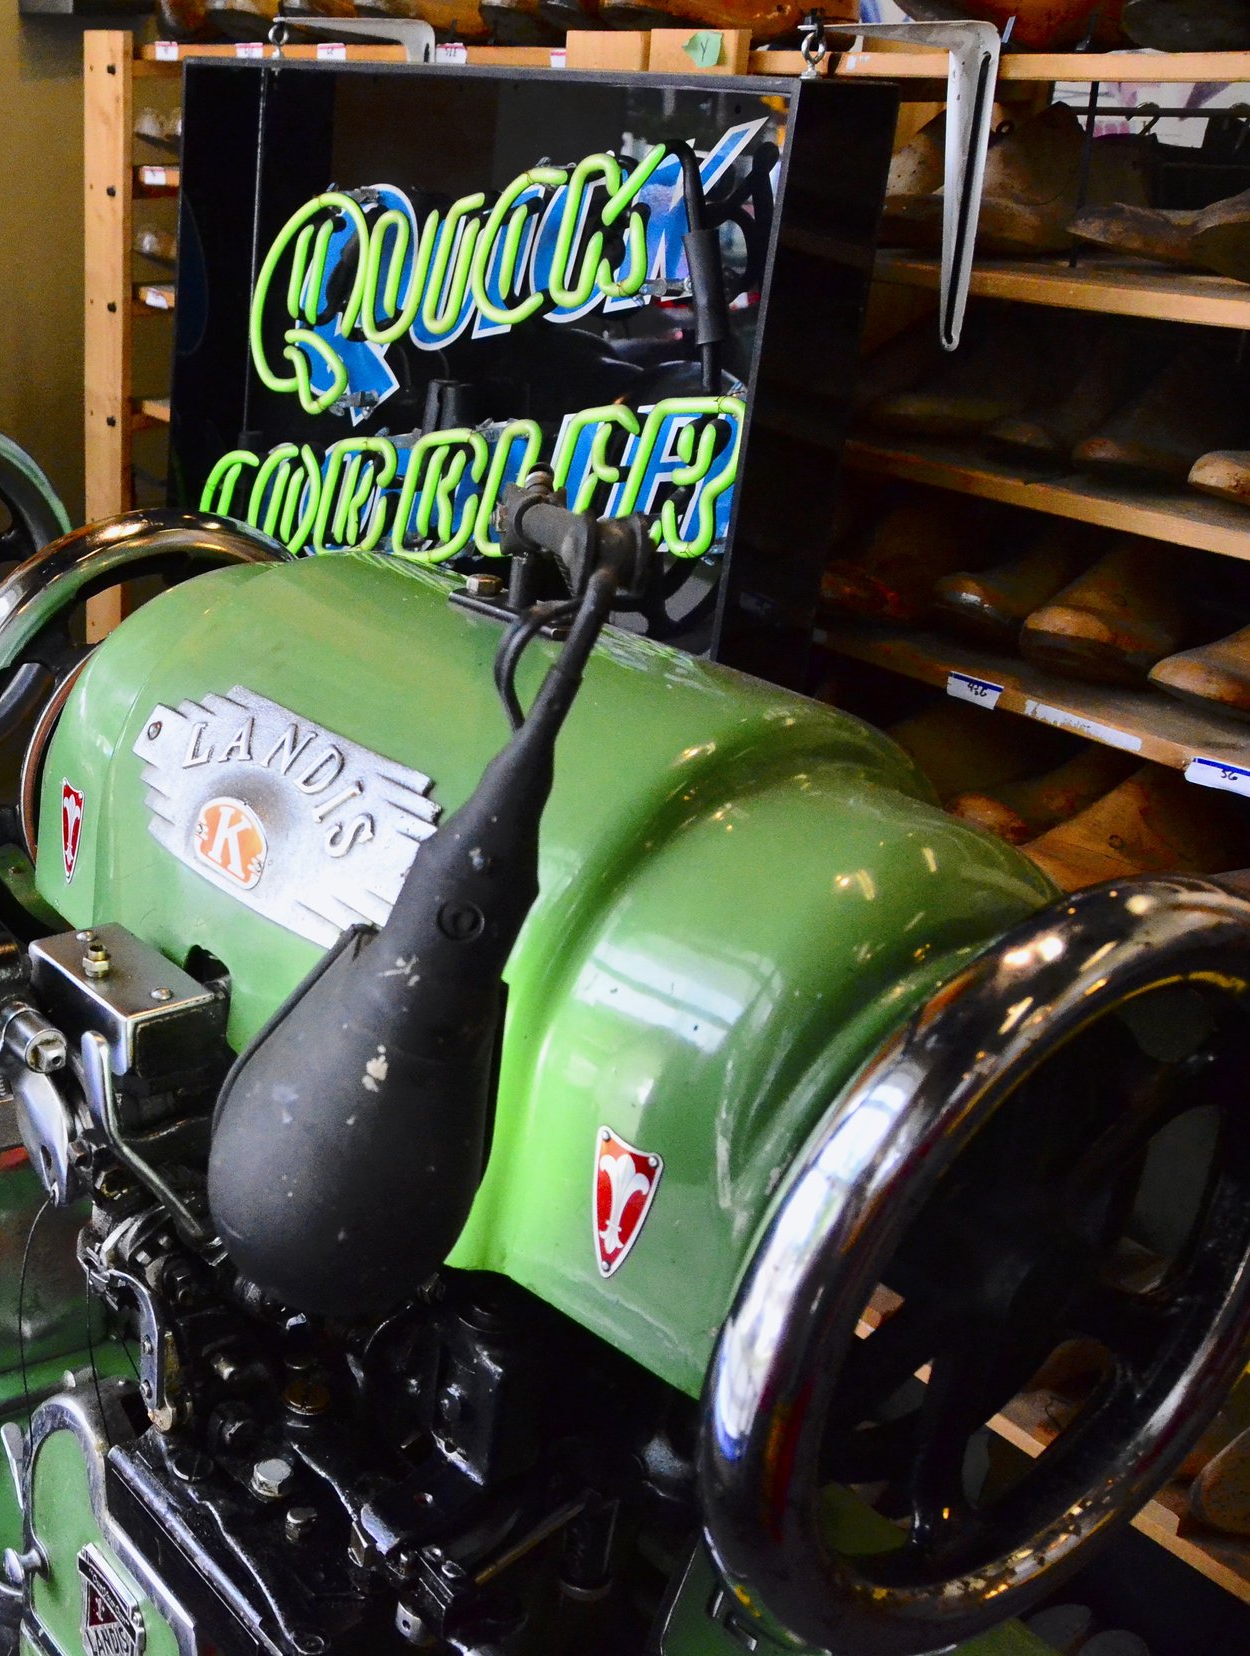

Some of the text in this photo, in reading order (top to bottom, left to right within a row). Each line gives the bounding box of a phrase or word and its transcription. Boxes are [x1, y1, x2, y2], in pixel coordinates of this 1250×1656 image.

[249, 117, 768, 426] QUICK
[200, 396, 746, 562] COBBLER
[181, 716, 376, 859] LANDIS
[209, 807, 251, 880] K
[86, 1626, 130, 1655] LANDIS
